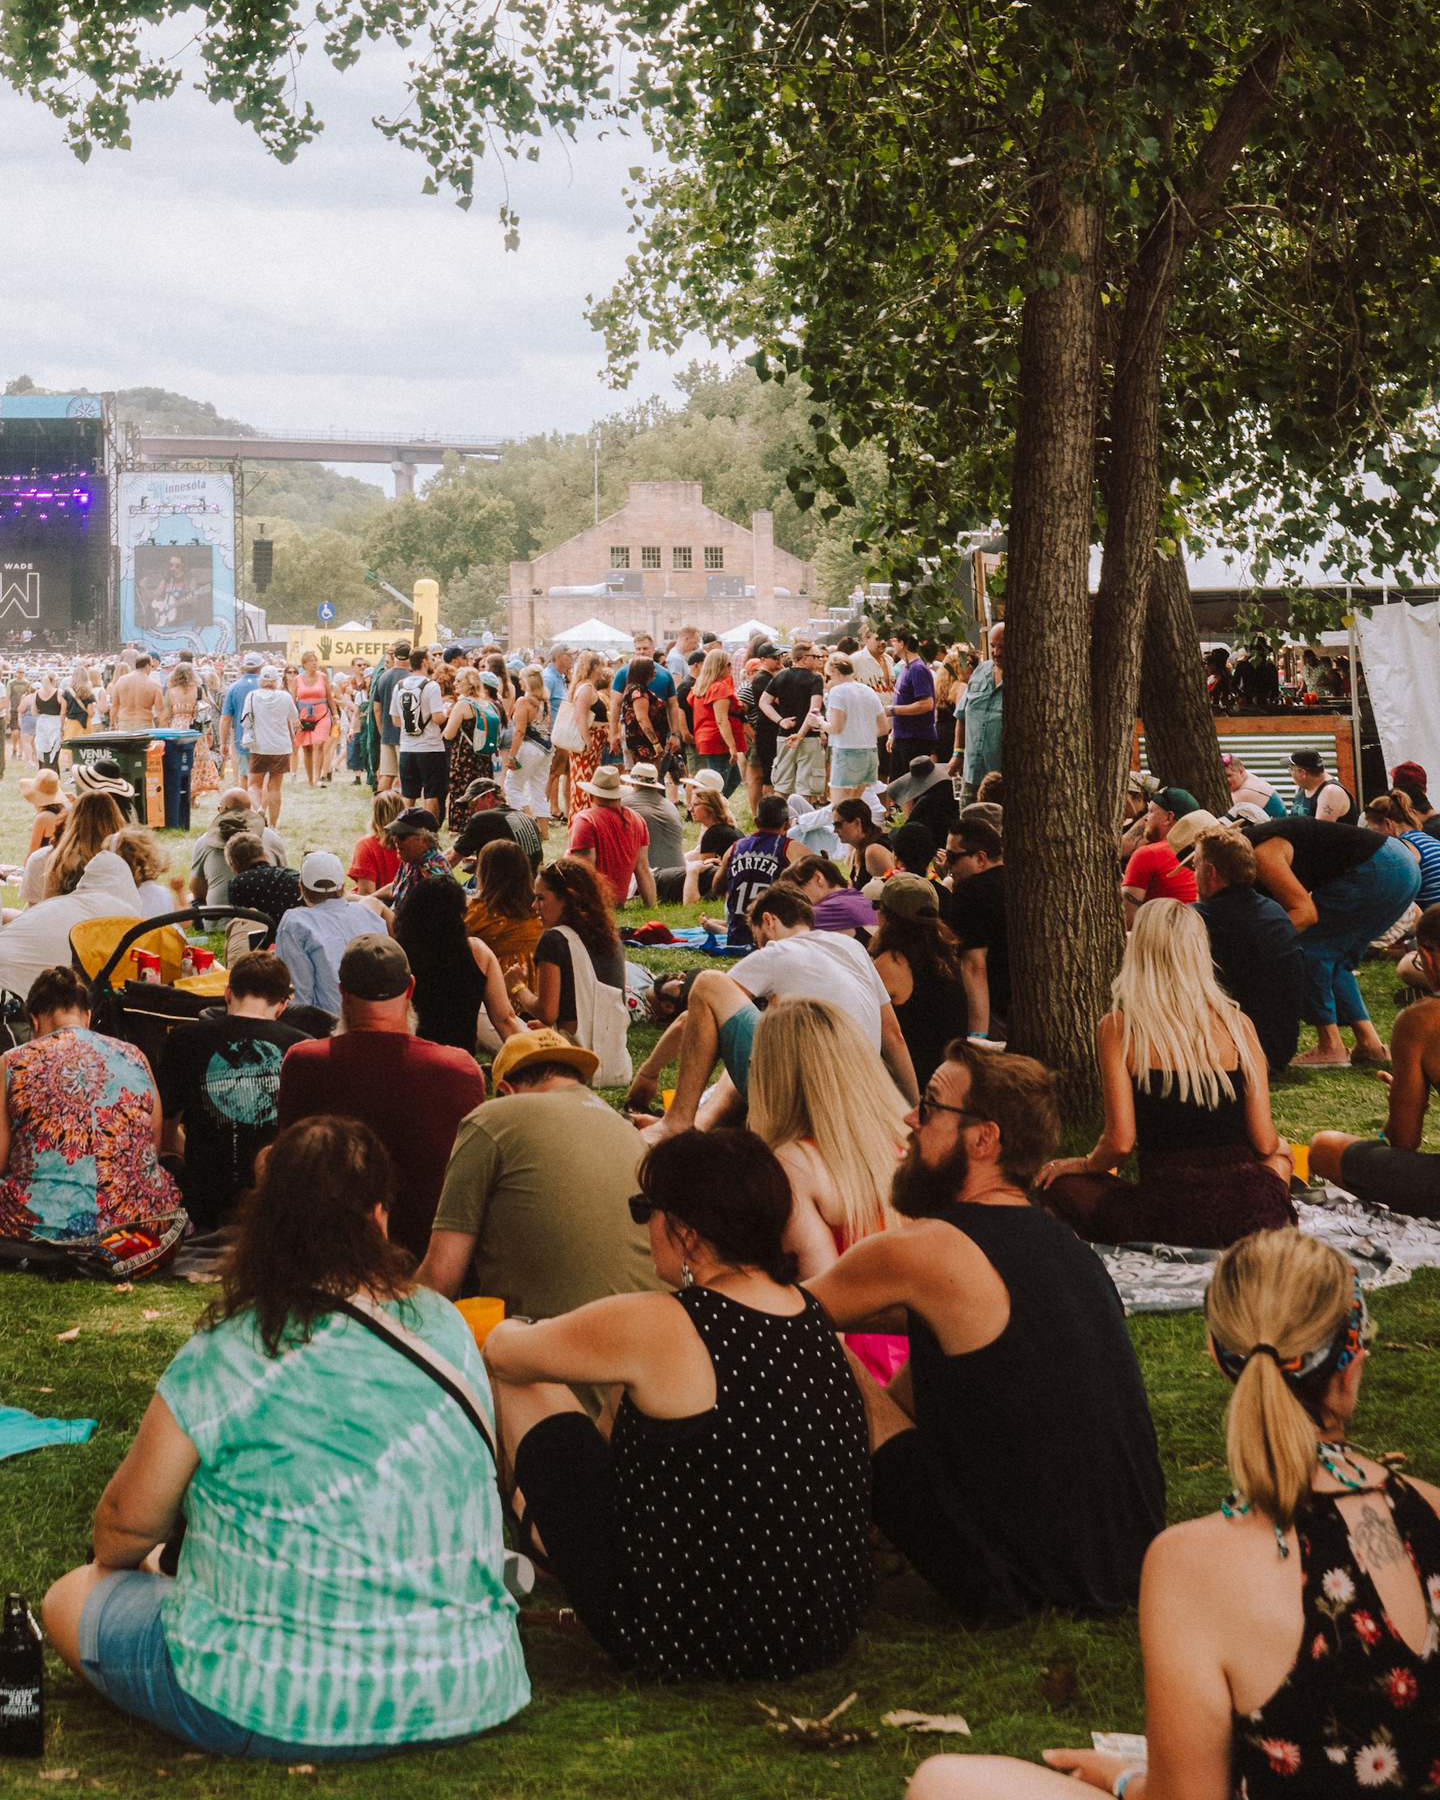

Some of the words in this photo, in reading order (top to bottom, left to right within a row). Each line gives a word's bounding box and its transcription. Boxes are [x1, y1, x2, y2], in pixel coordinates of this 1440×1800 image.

[147, 480, 206, 504] Minnesota
[79, 748, 112, 759] VENUE
[731, 857, 778, 877] CARTER
[9, 1693, 33, 1705] 2022
